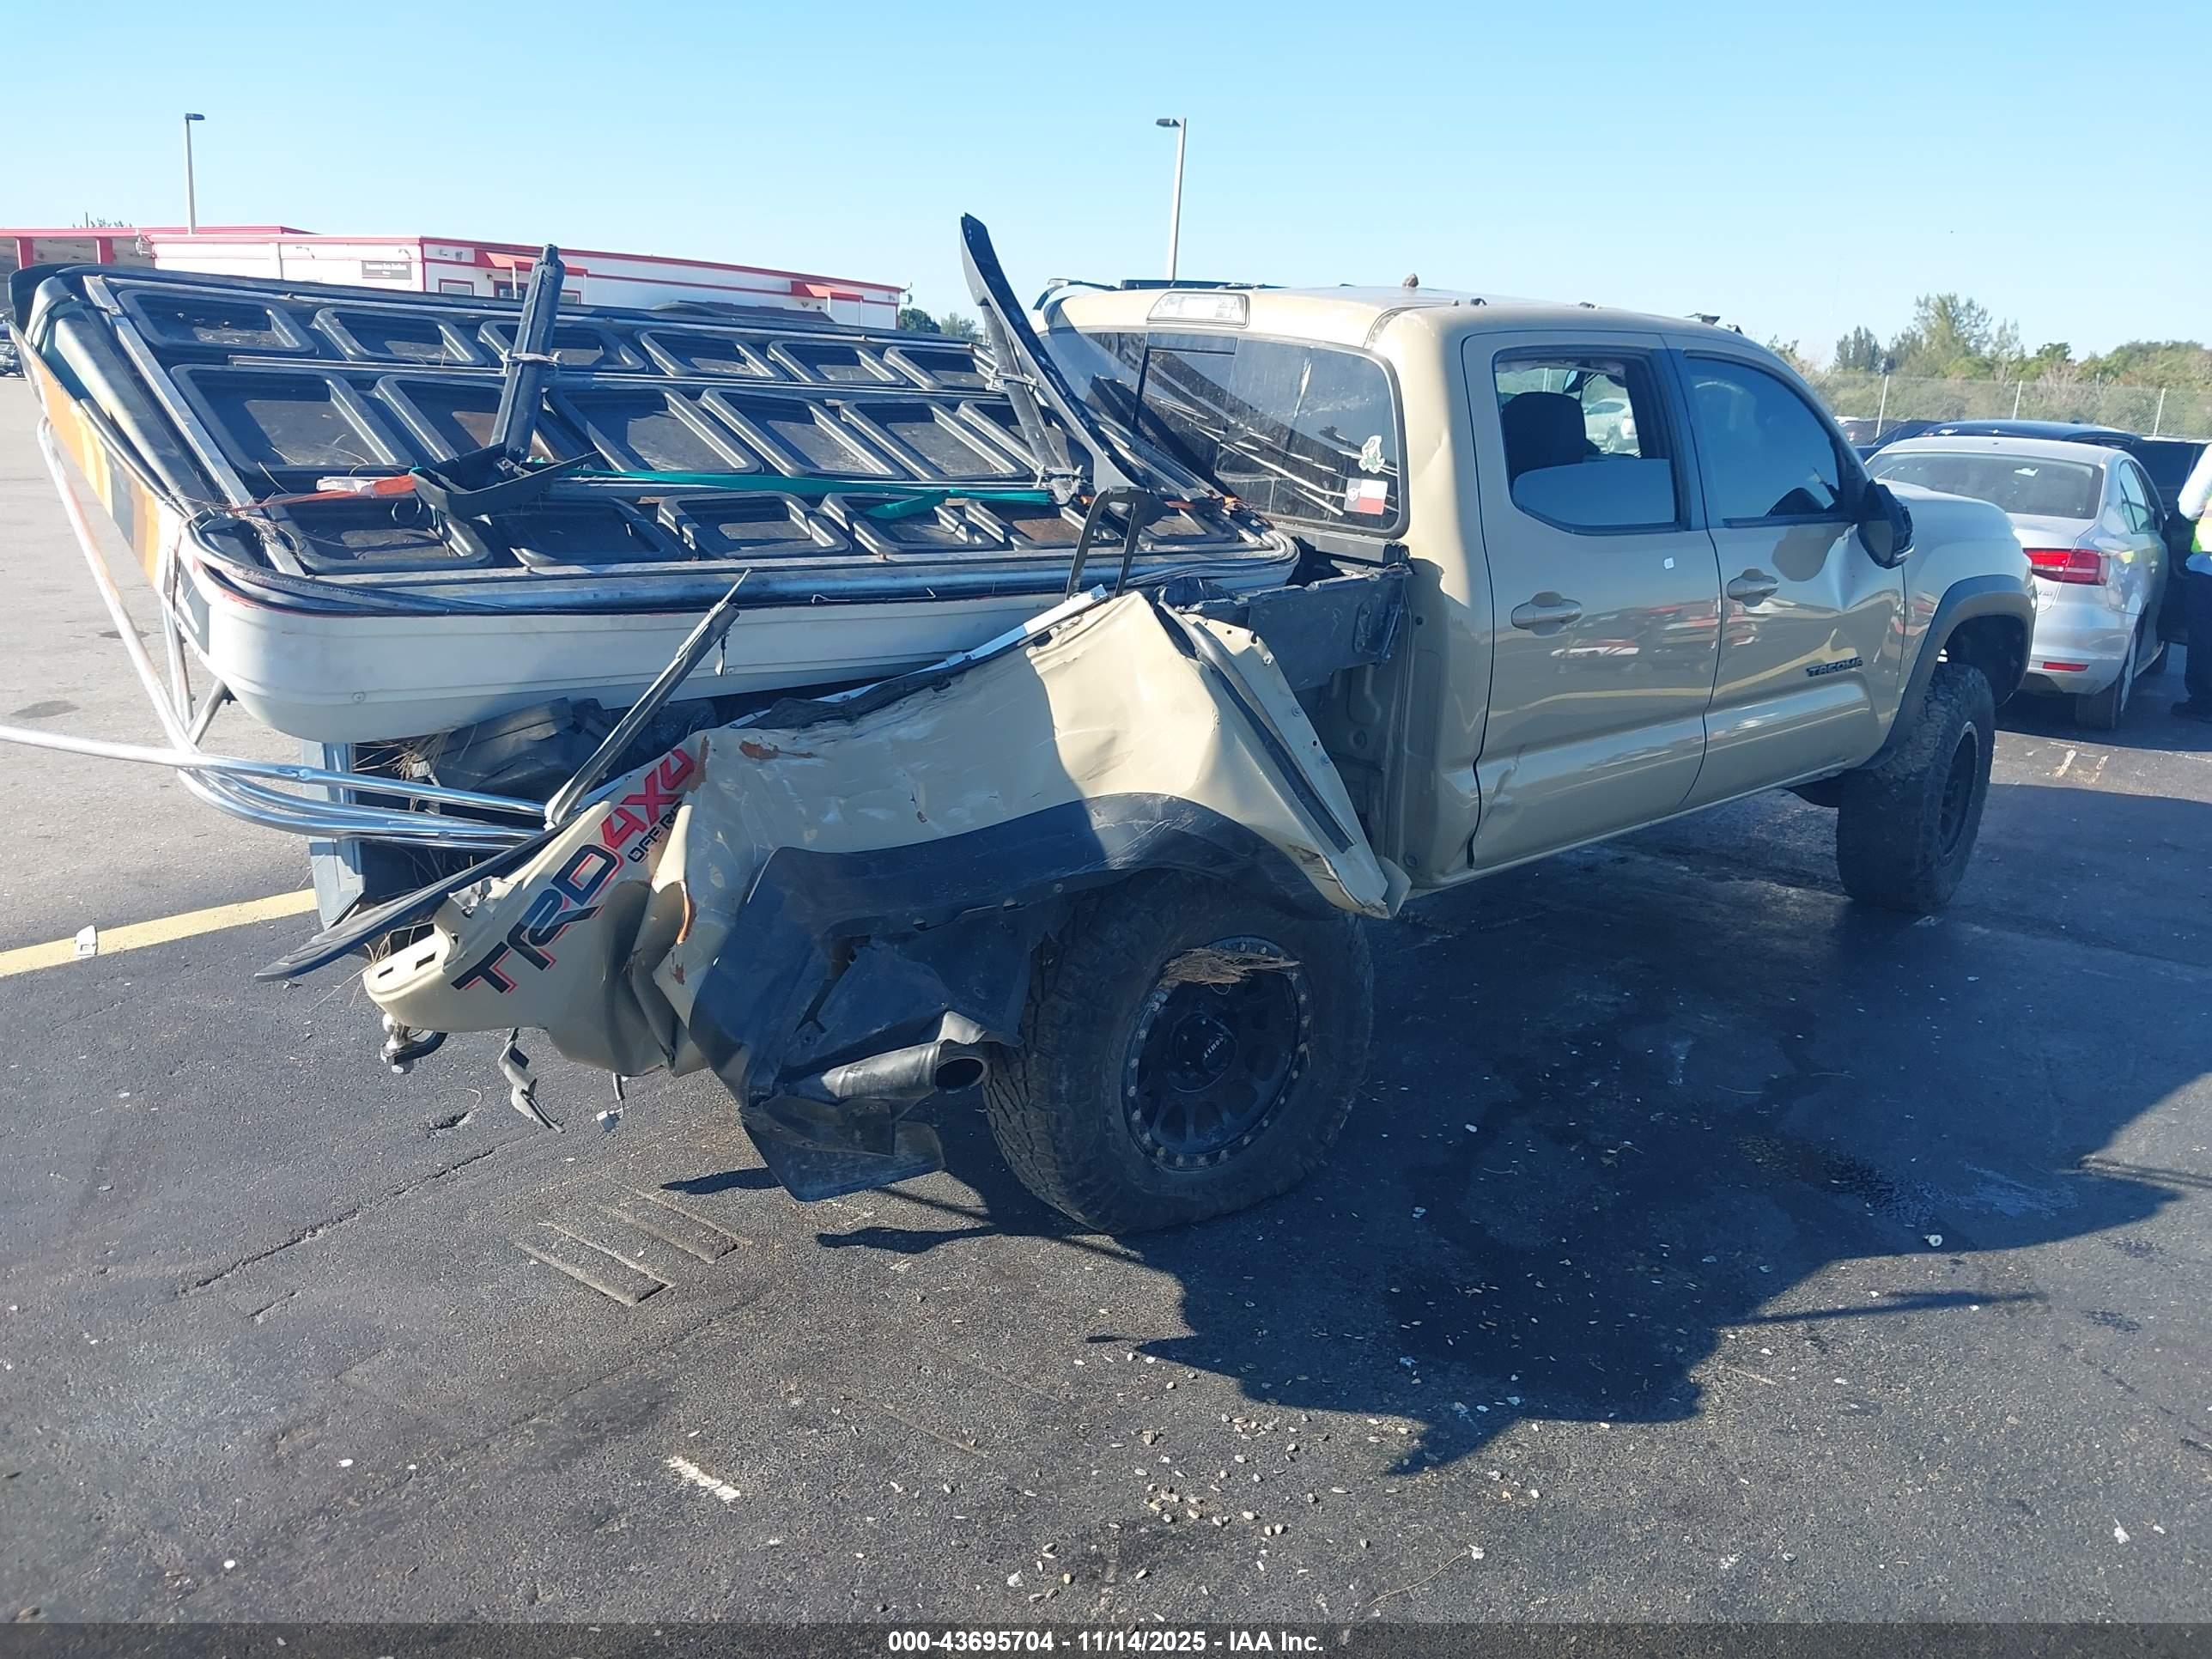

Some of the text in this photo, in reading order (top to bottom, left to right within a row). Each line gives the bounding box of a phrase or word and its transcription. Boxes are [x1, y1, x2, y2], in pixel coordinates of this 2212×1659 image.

[1807, 657, 1863, 677] TACOMA
[628, 826, 660, 863] OFF
[451, 844, 625, 994] TRD
